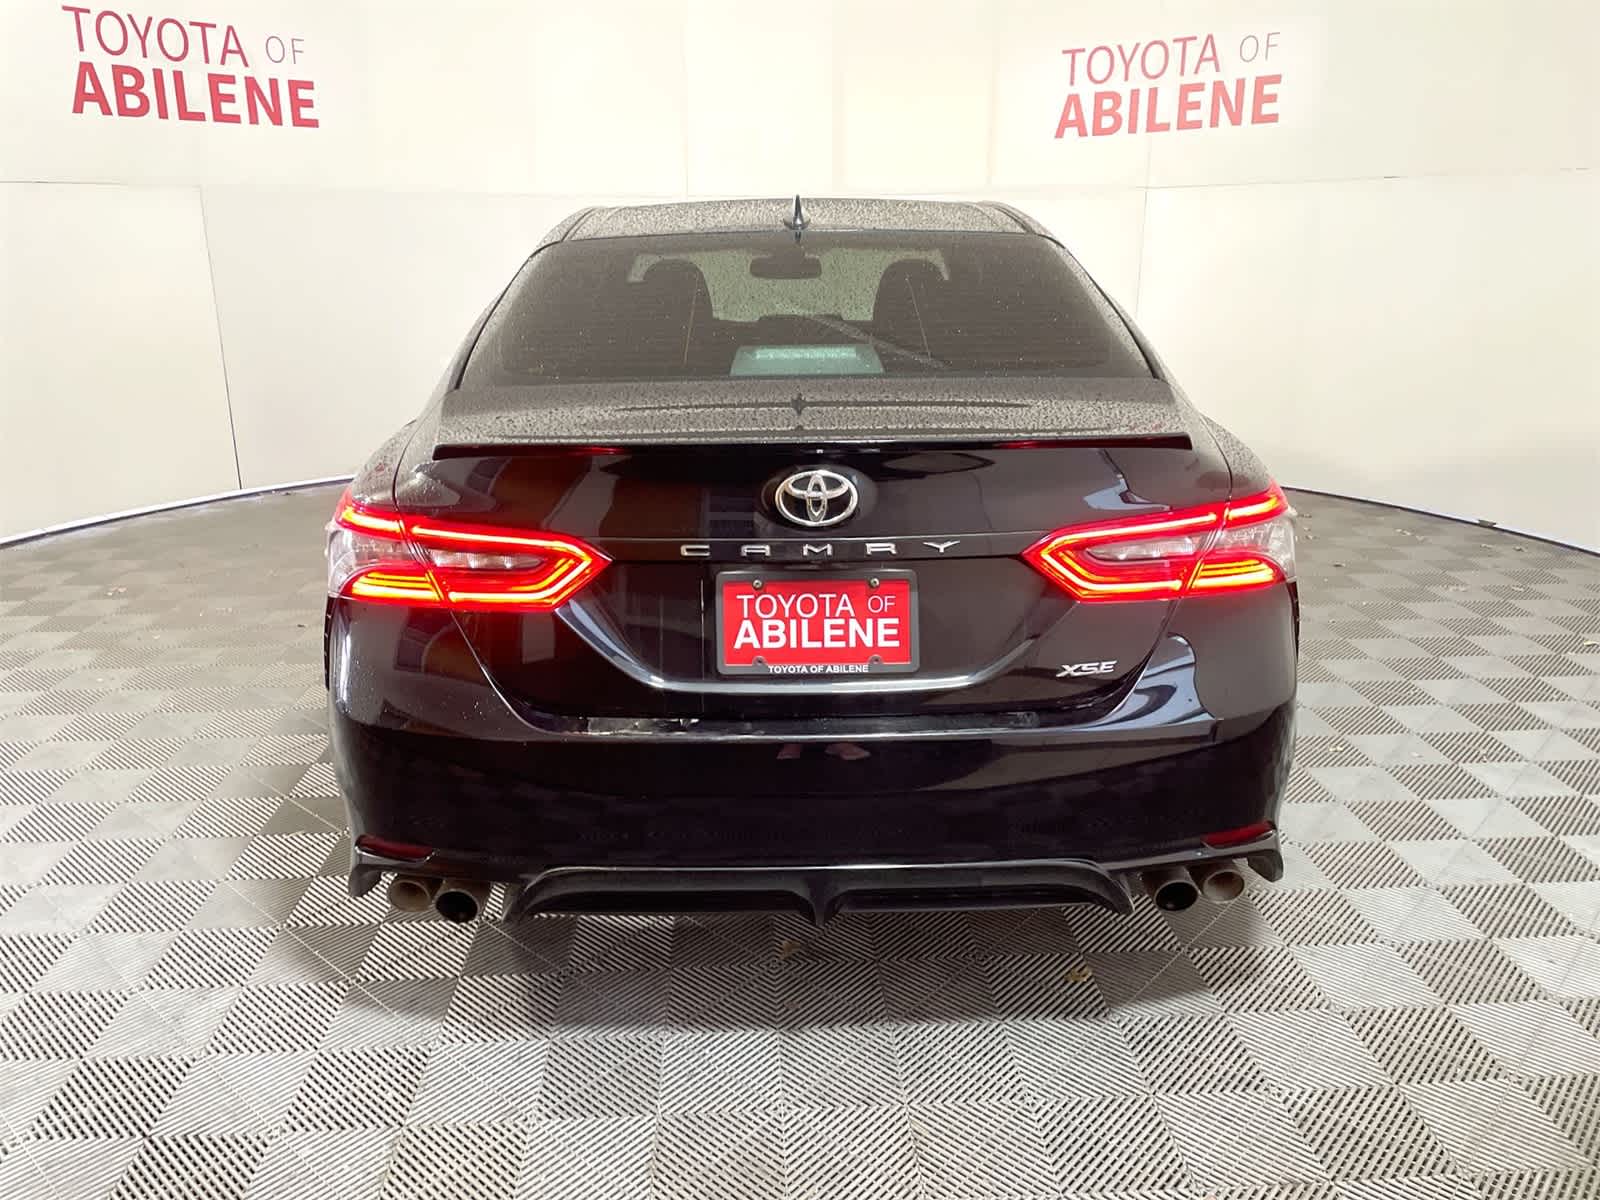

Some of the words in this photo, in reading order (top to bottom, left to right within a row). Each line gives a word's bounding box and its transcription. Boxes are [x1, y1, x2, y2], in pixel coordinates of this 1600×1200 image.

[62, 5, 249, 68] TOYOTA
[265, 35, 305, 65] OF
[1062, 33, 1221, 86] TOYOTA
[1239, 32, 1281, 63] OF
[72, 61, 320, 128] ABILENE
[1054, 74, 1282, 139] ABILENE
[680, 540, 961, 557] CAMRY
[736, 593, 855, 618] TOYOTA
[867, 595, 896, 614] OF
[733, 618, 900, 649] ABILENE
[768, 665, 808, 674] TOYOTA
[810, 665, 824, 673] OF
[826, 665, 869, 673] ABILENE
[1056, 660, 1118, 678] XSE
